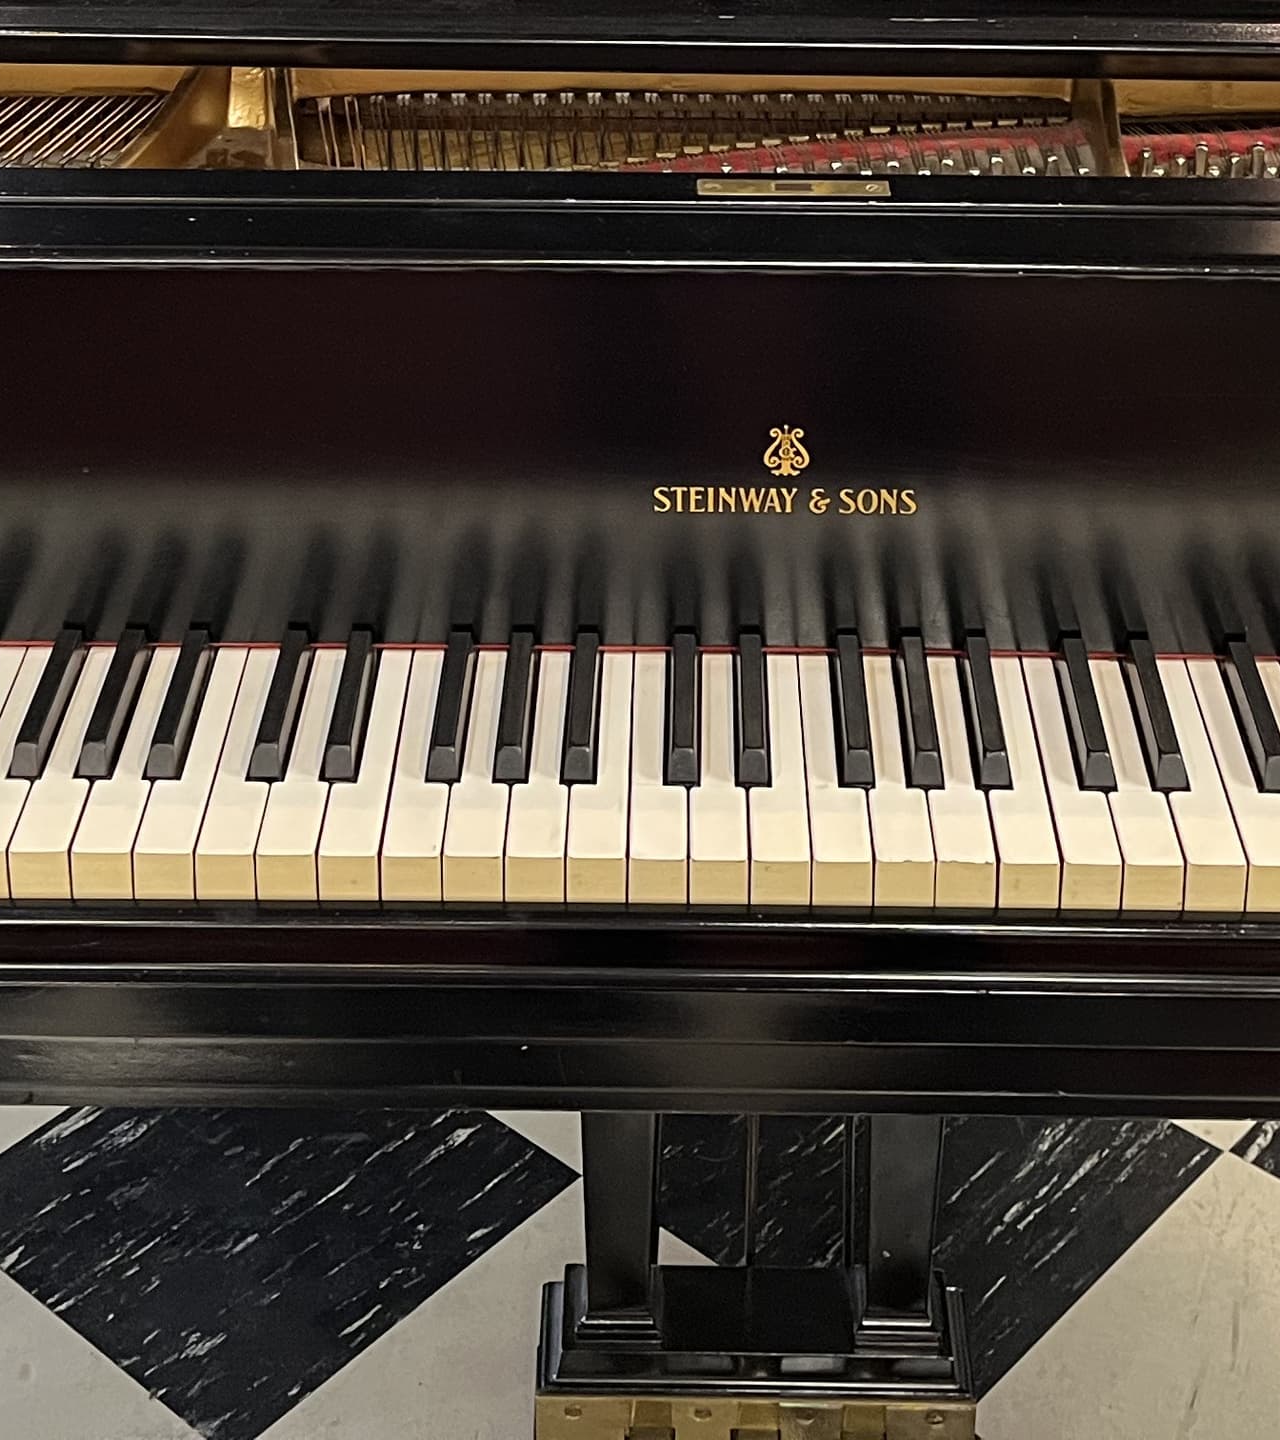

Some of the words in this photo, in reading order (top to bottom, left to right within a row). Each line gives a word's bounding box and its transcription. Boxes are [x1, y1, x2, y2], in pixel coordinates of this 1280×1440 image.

[653, 486, 798, 513] STEINWAY
[808, 488, 831, 514] &
[838, 489, 918, 515] SONS
